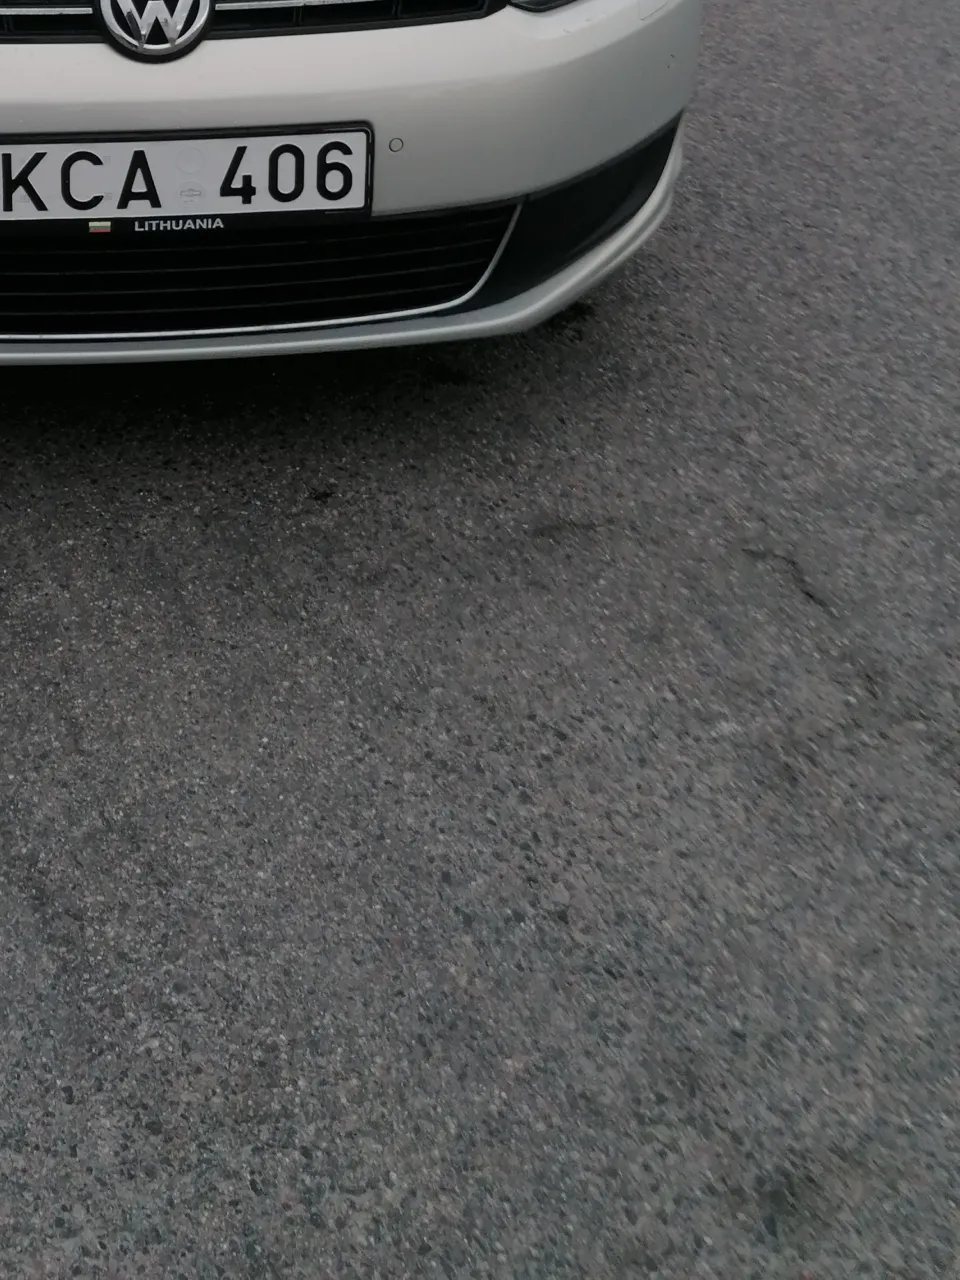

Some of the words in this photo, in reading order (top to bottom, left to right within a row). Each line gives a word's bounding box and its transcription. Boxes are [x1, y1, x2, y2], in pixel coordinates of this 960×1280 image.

[1, 150, 162, 212] KCA
[219, 141, 353, 205] 406
[134, 218, 224, 232] LITHUANIA
